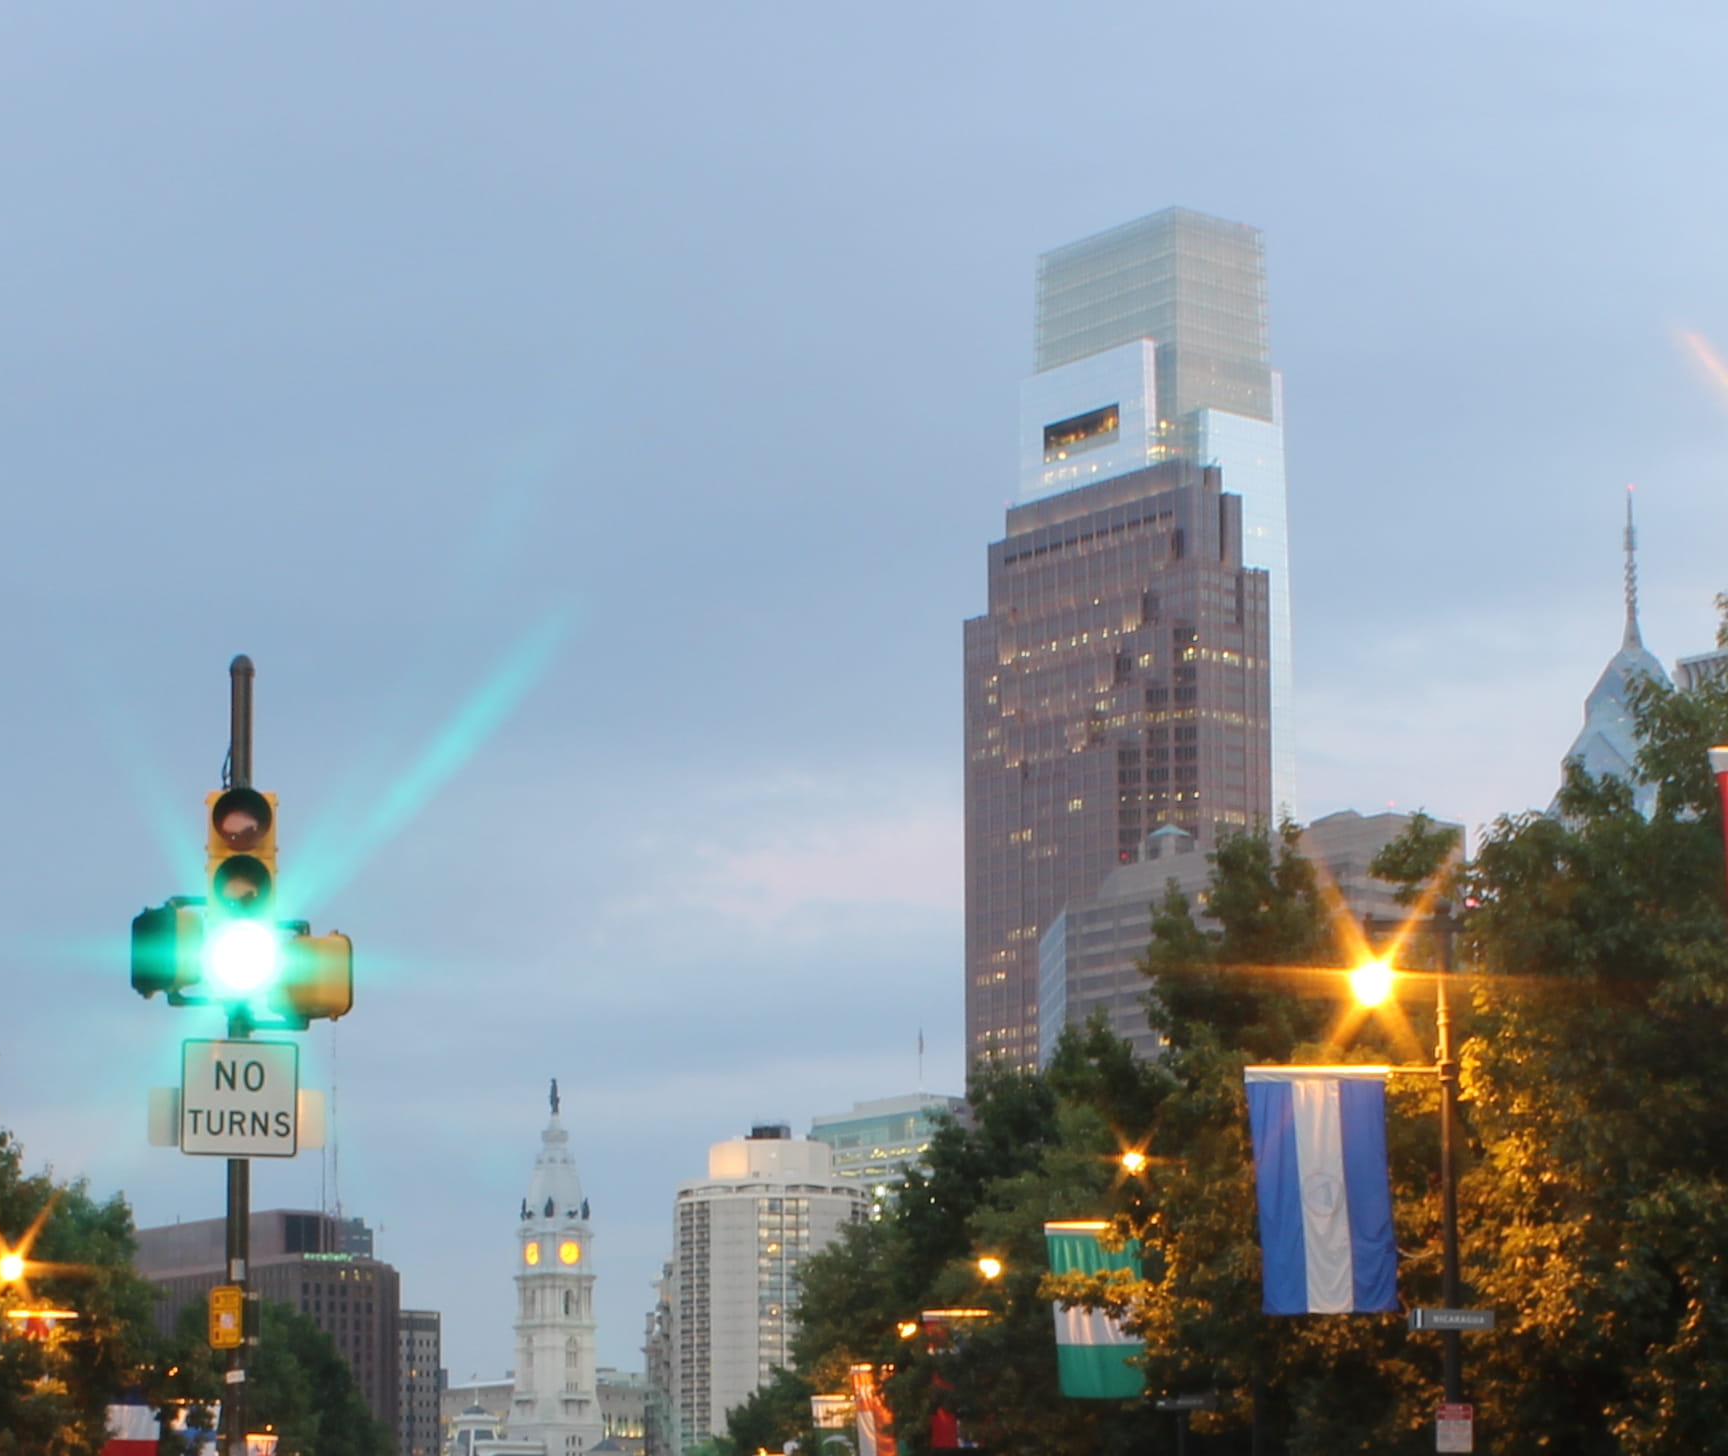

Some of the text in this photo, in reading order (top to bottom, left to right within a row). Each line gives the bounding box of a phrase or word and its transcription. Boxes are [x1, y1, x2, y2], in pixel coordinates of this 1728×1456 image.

[215, 1060, 265, 1092] NO
[188, 1109, 291, 1137] TURNS
[1433, 1315, 1485, 1324] NICARAGUA
